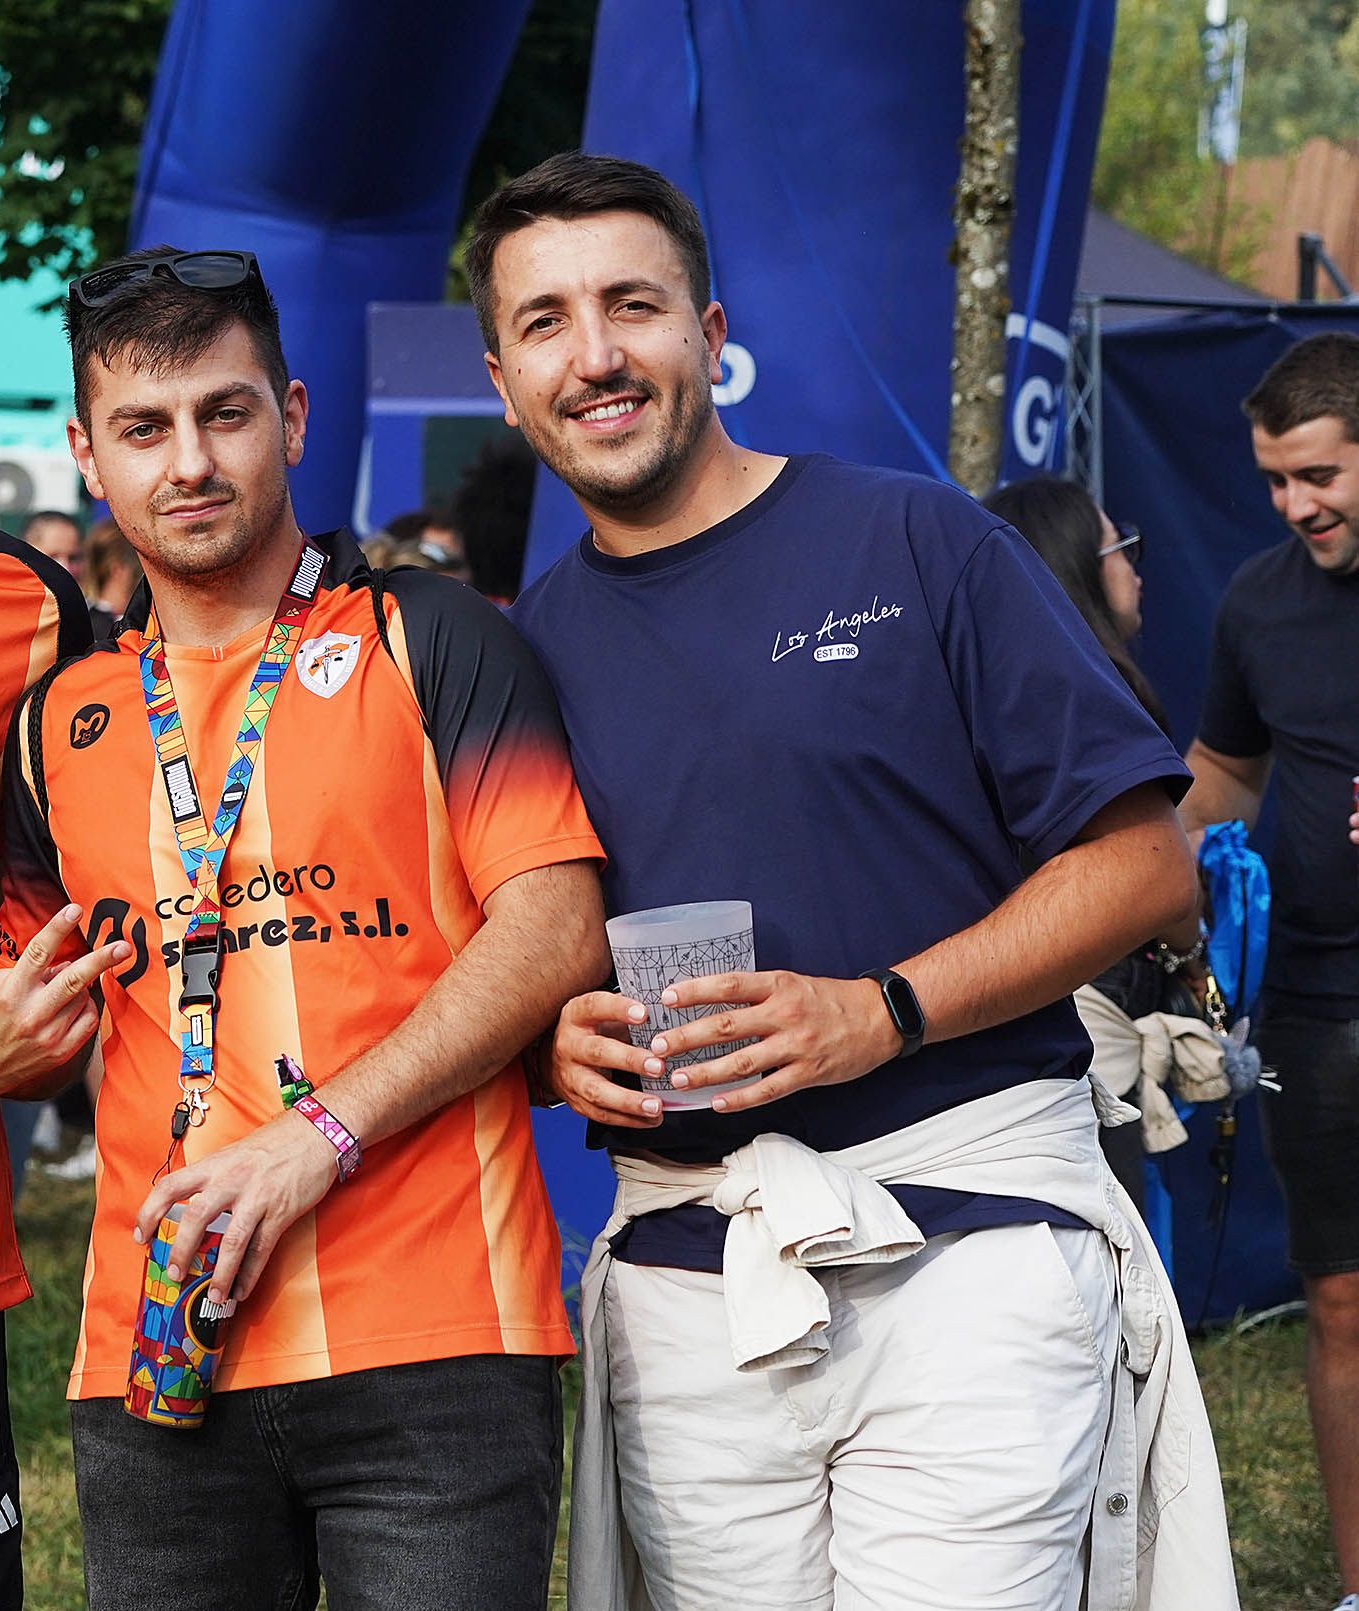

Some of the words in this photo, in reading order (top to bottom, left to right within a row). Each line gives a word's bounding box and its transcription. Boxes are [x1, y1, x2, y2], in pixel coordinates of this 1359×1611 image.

[291, 546, 324, 598] bigsound
[772, 631, 809, 662] Los
[816, 595, 904, 641] Angeles
[816, 648, 834, 659] EST
[836, 646, 856, 657] 1796
[154, 864, 335, 920] coedero
[161, 914, 331, 969] sárez,
[339, 897, 409, 937] s.l.
